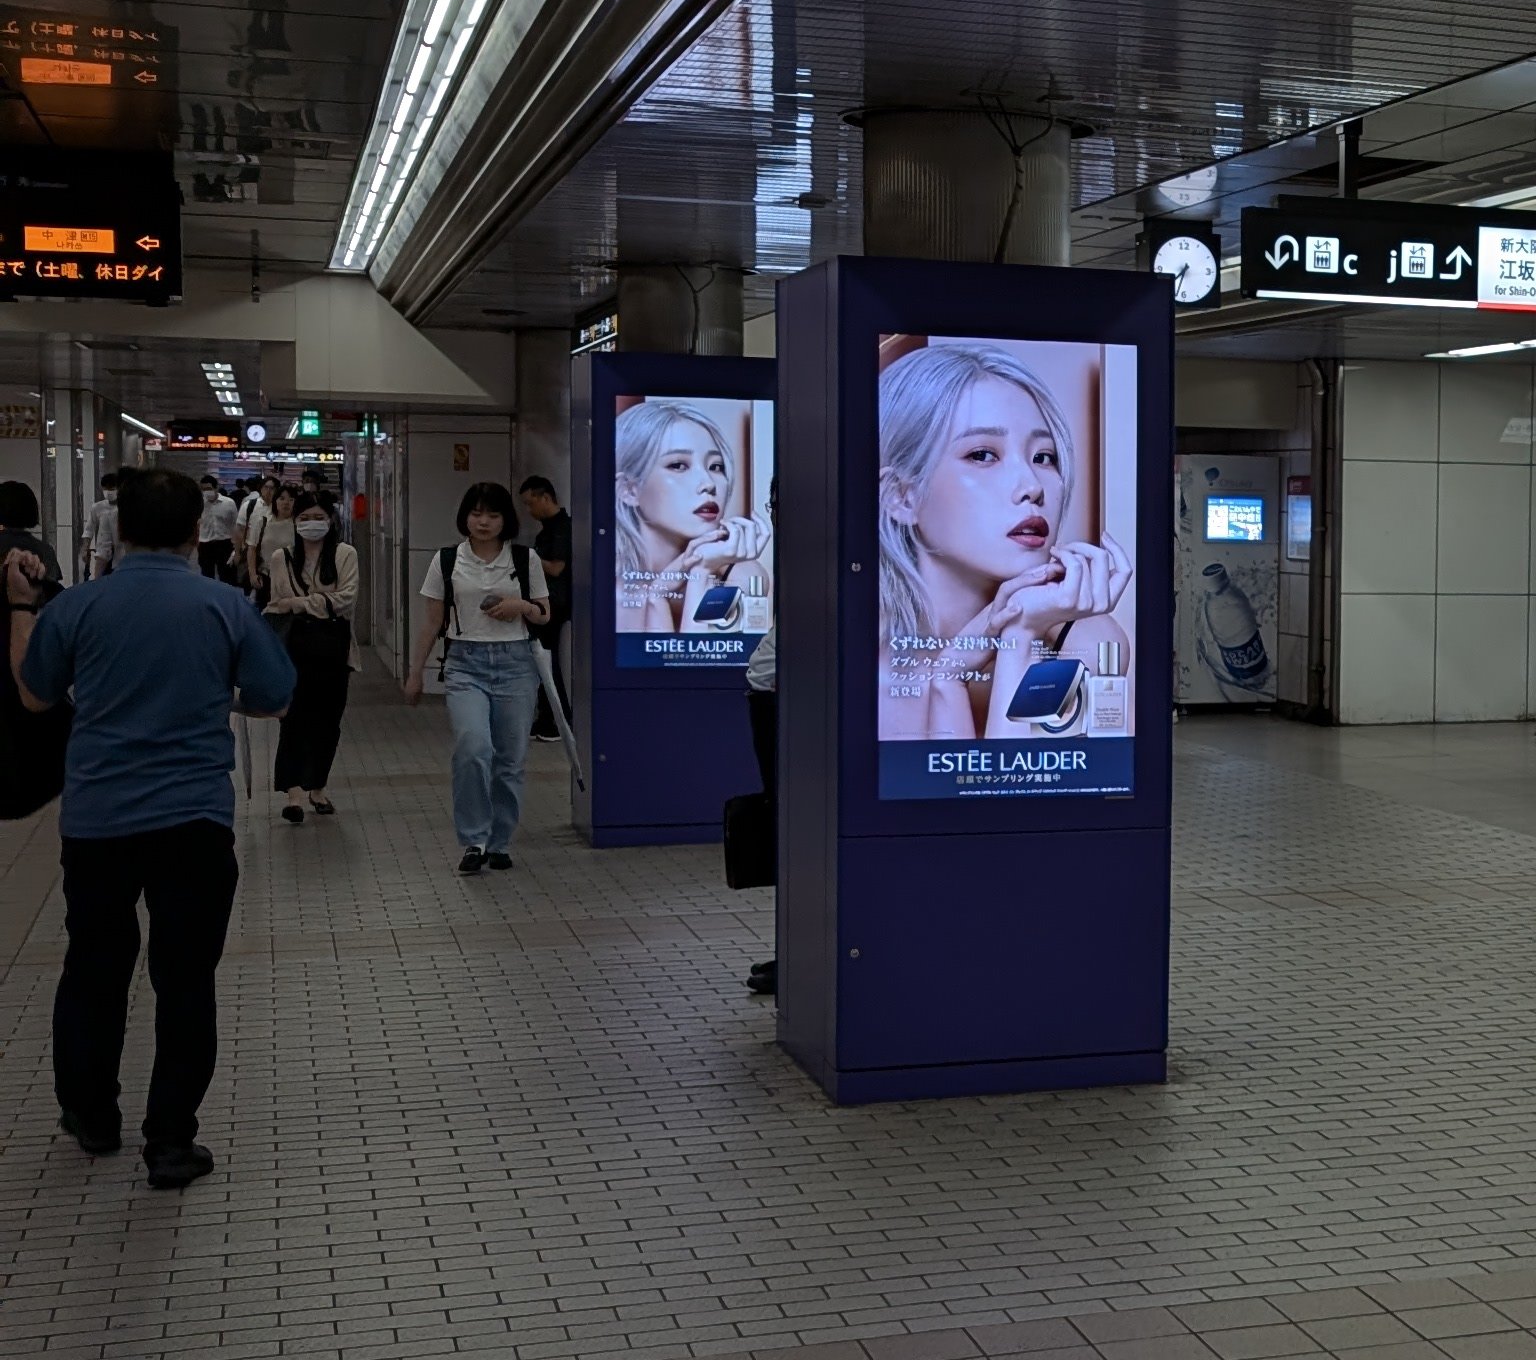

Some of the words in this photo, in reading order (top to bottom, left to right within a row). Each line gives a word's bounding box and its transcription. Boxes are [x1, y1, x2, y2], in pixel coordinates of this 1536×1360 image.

[1343, 254, 1359, 275] c
[1387, 250, 1398, 284] j
[1495, 285, 1507, 295] for
[688, 640, 744, 653] LAUDER
[1000, 750, 1087, 772] LAUDER
